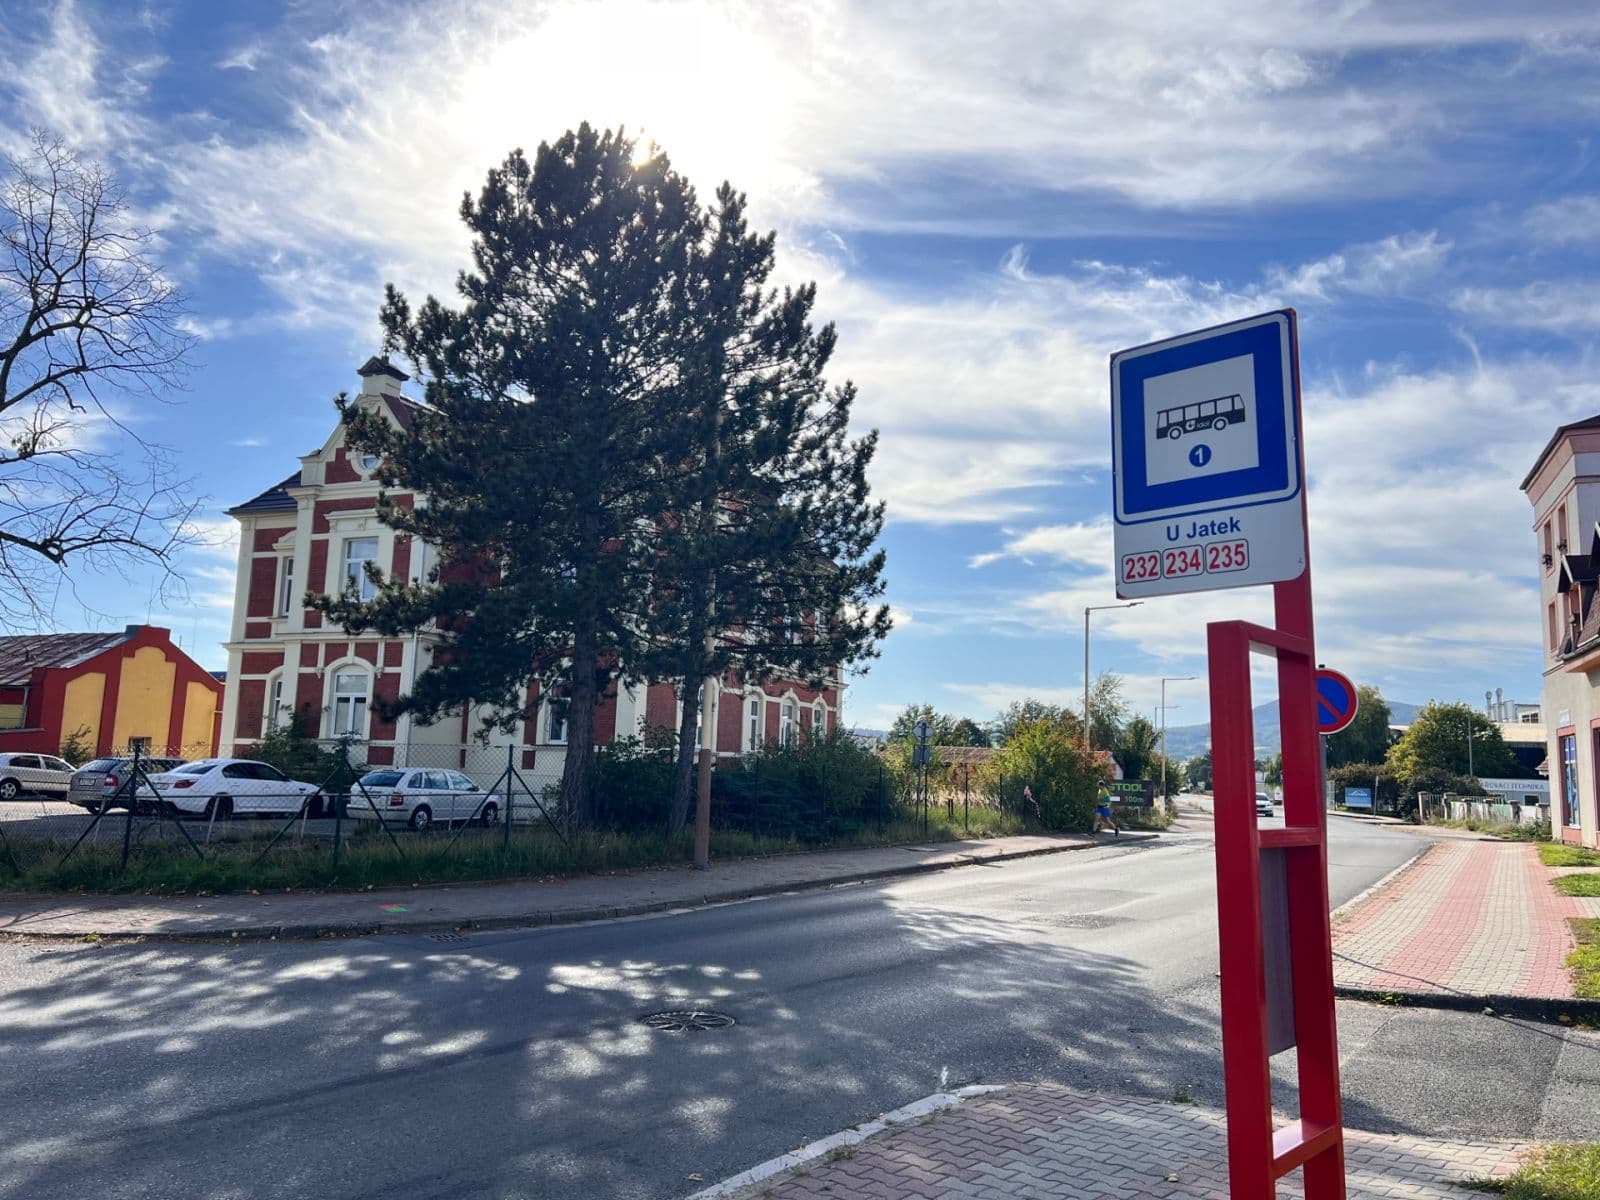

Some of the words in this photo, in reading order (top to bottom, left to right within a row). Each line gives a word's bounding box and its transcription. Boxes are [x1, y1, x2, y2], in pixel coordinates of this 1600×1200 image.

[1166, 525, 1180, 541] U
[1186, 516, 1241, 539] Jatek
[1125, 554, 1159, 580] 232
[1165, 548, 1201, 576] 234
[1208, 543, 1246, 570] 235
[1110, 783, 1147, 792] STOOL
